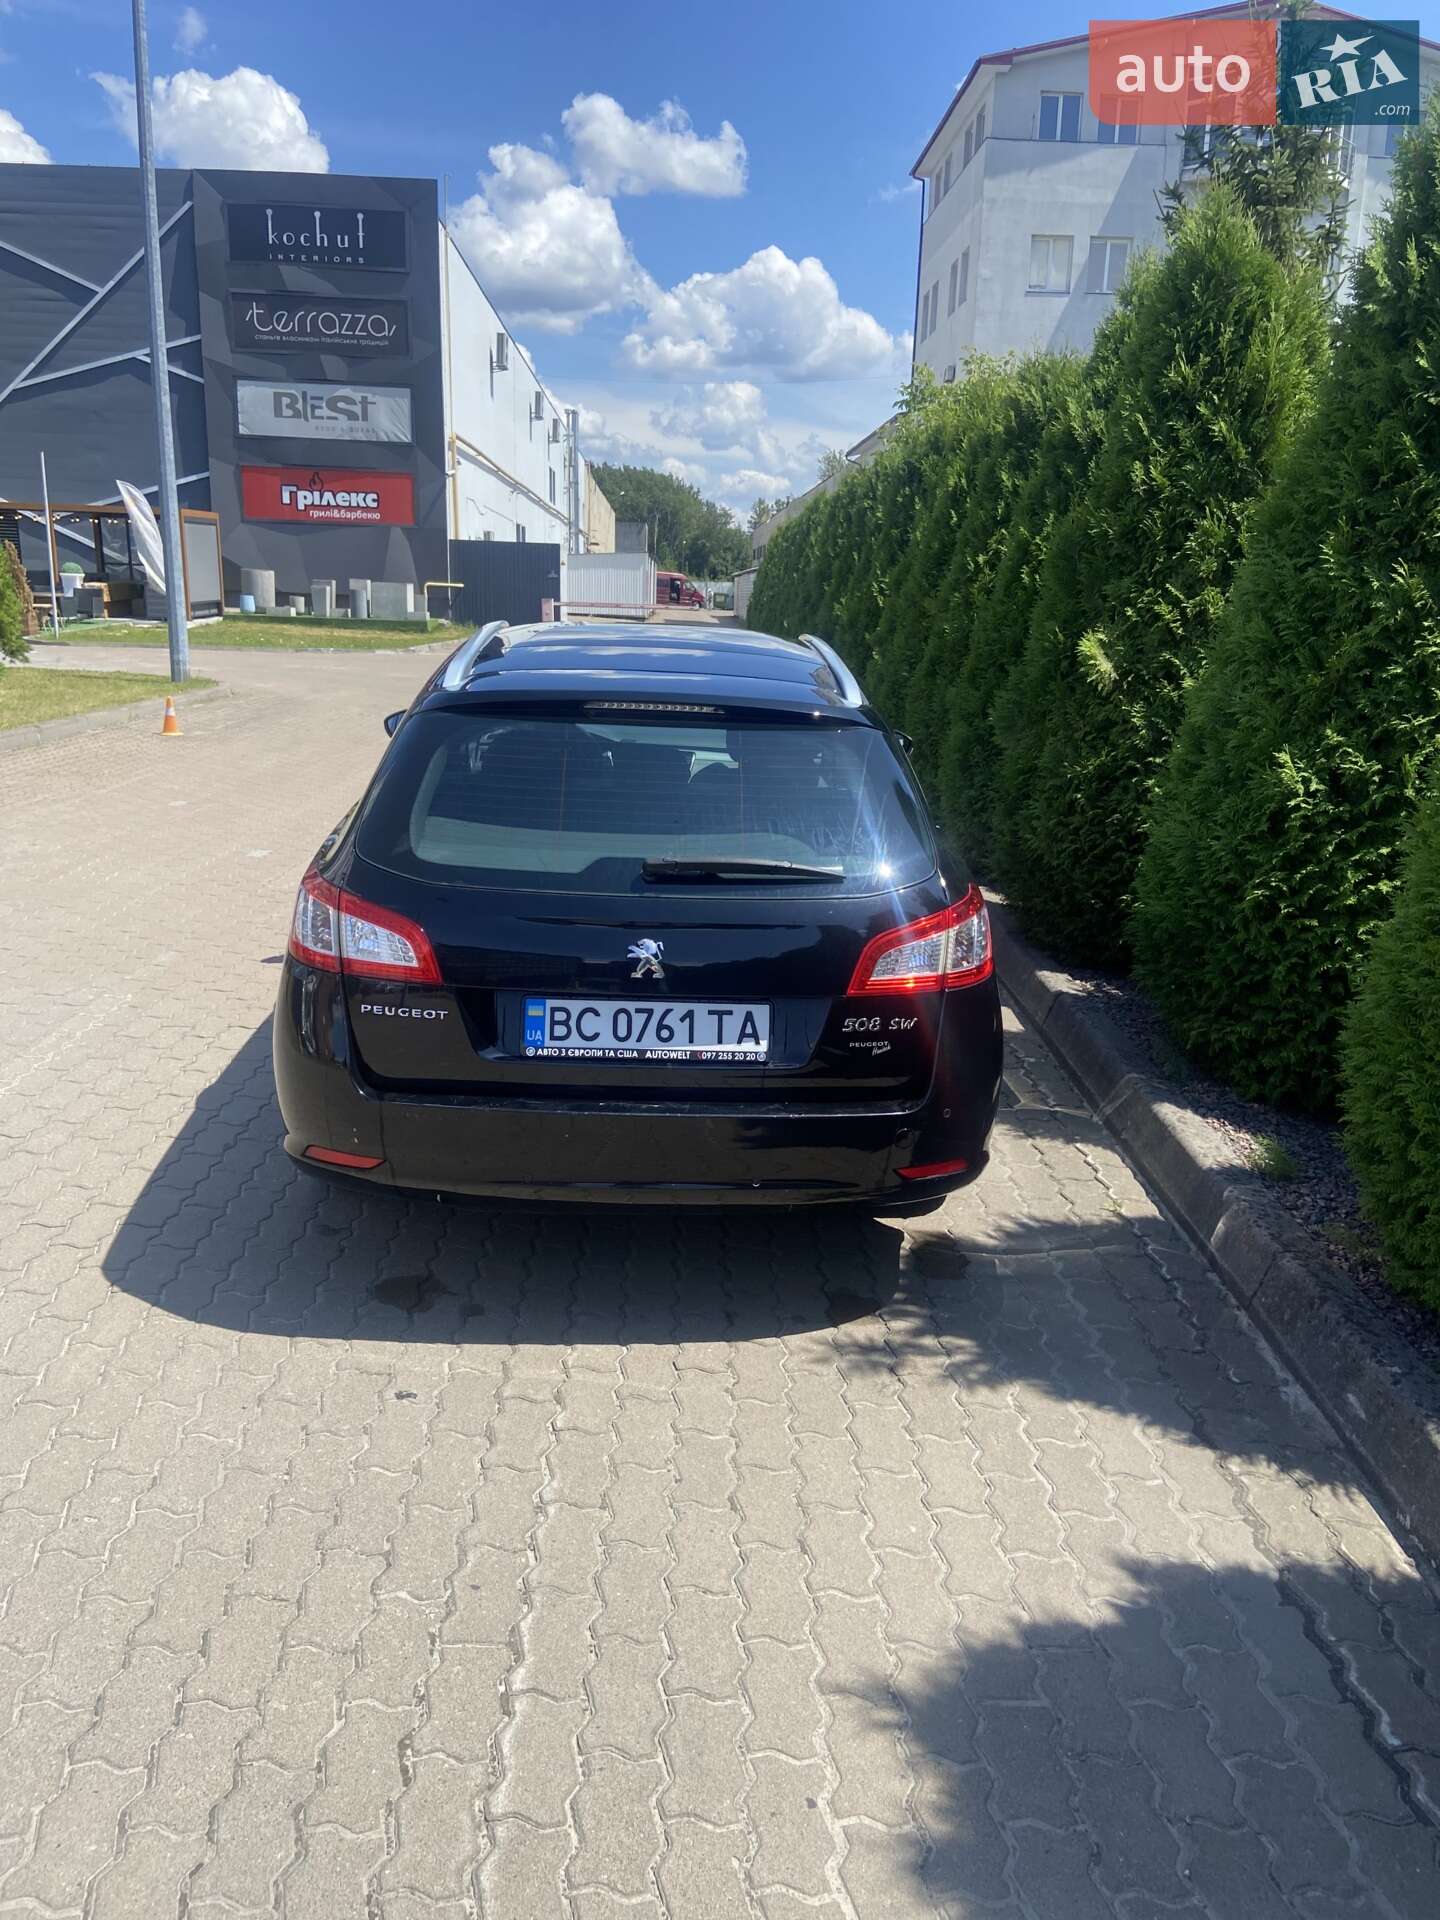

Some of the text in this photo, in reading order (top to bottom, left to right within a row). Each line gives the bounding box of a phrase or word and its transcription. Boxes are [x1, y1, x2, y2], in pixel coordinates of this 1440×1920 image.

[265, 208, 365, 249] kochut
[268, 252, 365, 264] INTERIORS
[281, 485, 379, 511] Грілекс
[309, 509, 381, 520] грилі&барбекю
[360, 1004, 449, 1020] PEUGEOT
[549, 1006, 761, 1046] BC 0761 TA
[841, 1016, 918, 1032] 508 SW
[526, 1029, 543, 1042] UA
[849, 1040, 889, 1048] PEUGEOT
[536, 1048, 559, 1057] АВТО
[567, 1048, 604, 1058] ЄВРОПИ
[604, 1049, 616, 1058] ТА
[617, 1049, 639, 1058] США
[645, 1050, 691, 1060] AUTOWELT
[701, 1051, 756, 1061] 097 255 20 20
